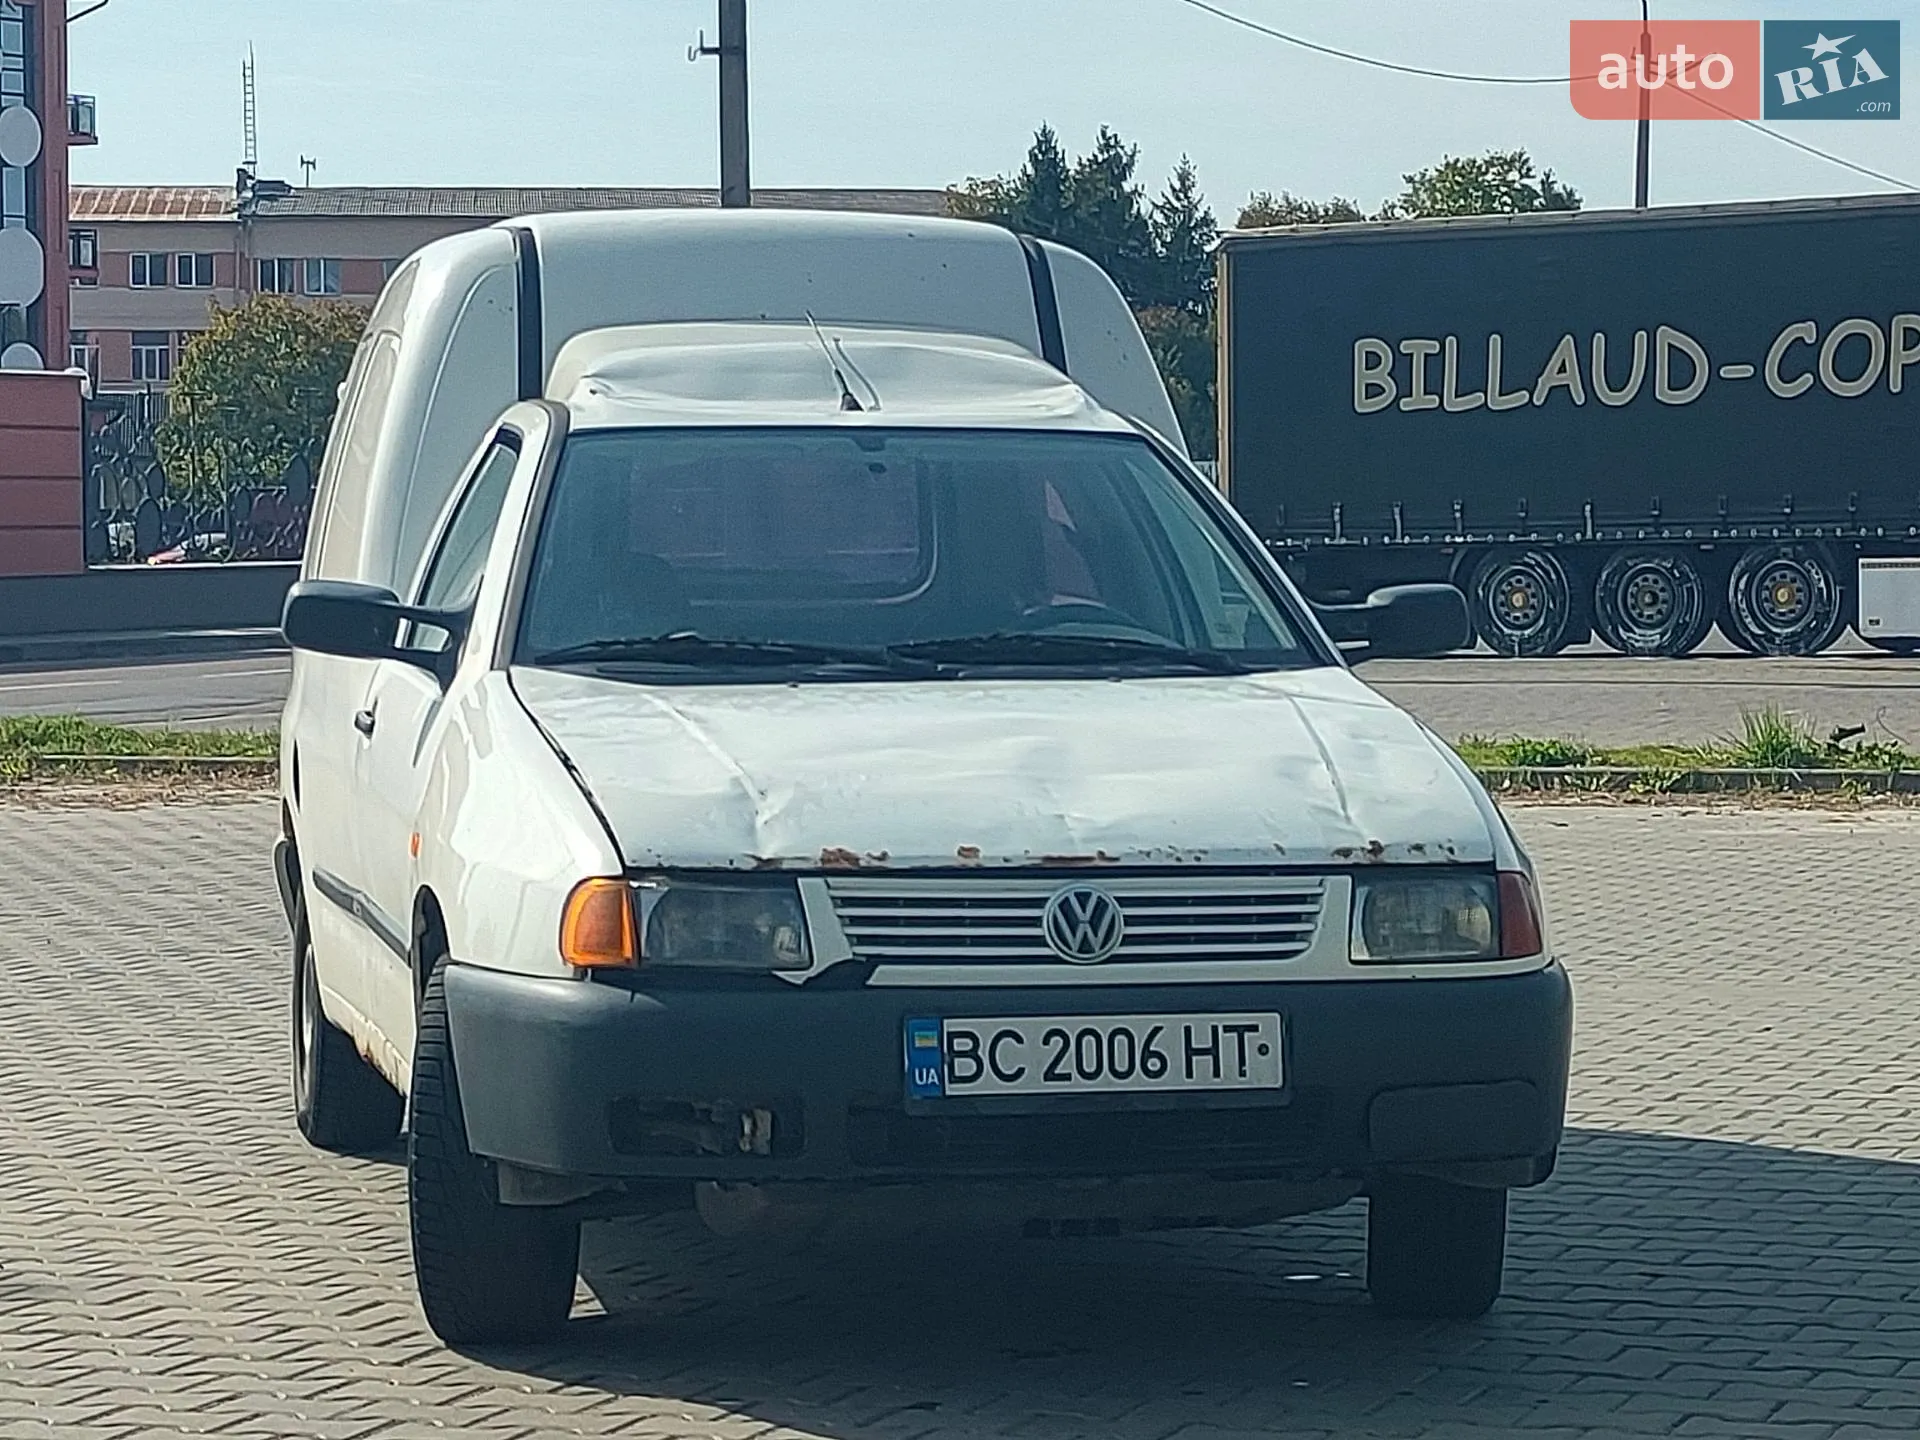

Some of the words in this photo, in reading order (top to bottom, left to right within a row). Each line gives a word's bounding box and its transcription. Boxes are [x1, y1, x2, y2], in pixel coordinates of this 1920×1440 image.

[946, 1029, 1026, 1085] BC
[1041, 1025, 1169, 1084] 2006
[1183, 1023, 1260, 1081] HT
[914, 1067, 940, 1086] UA
